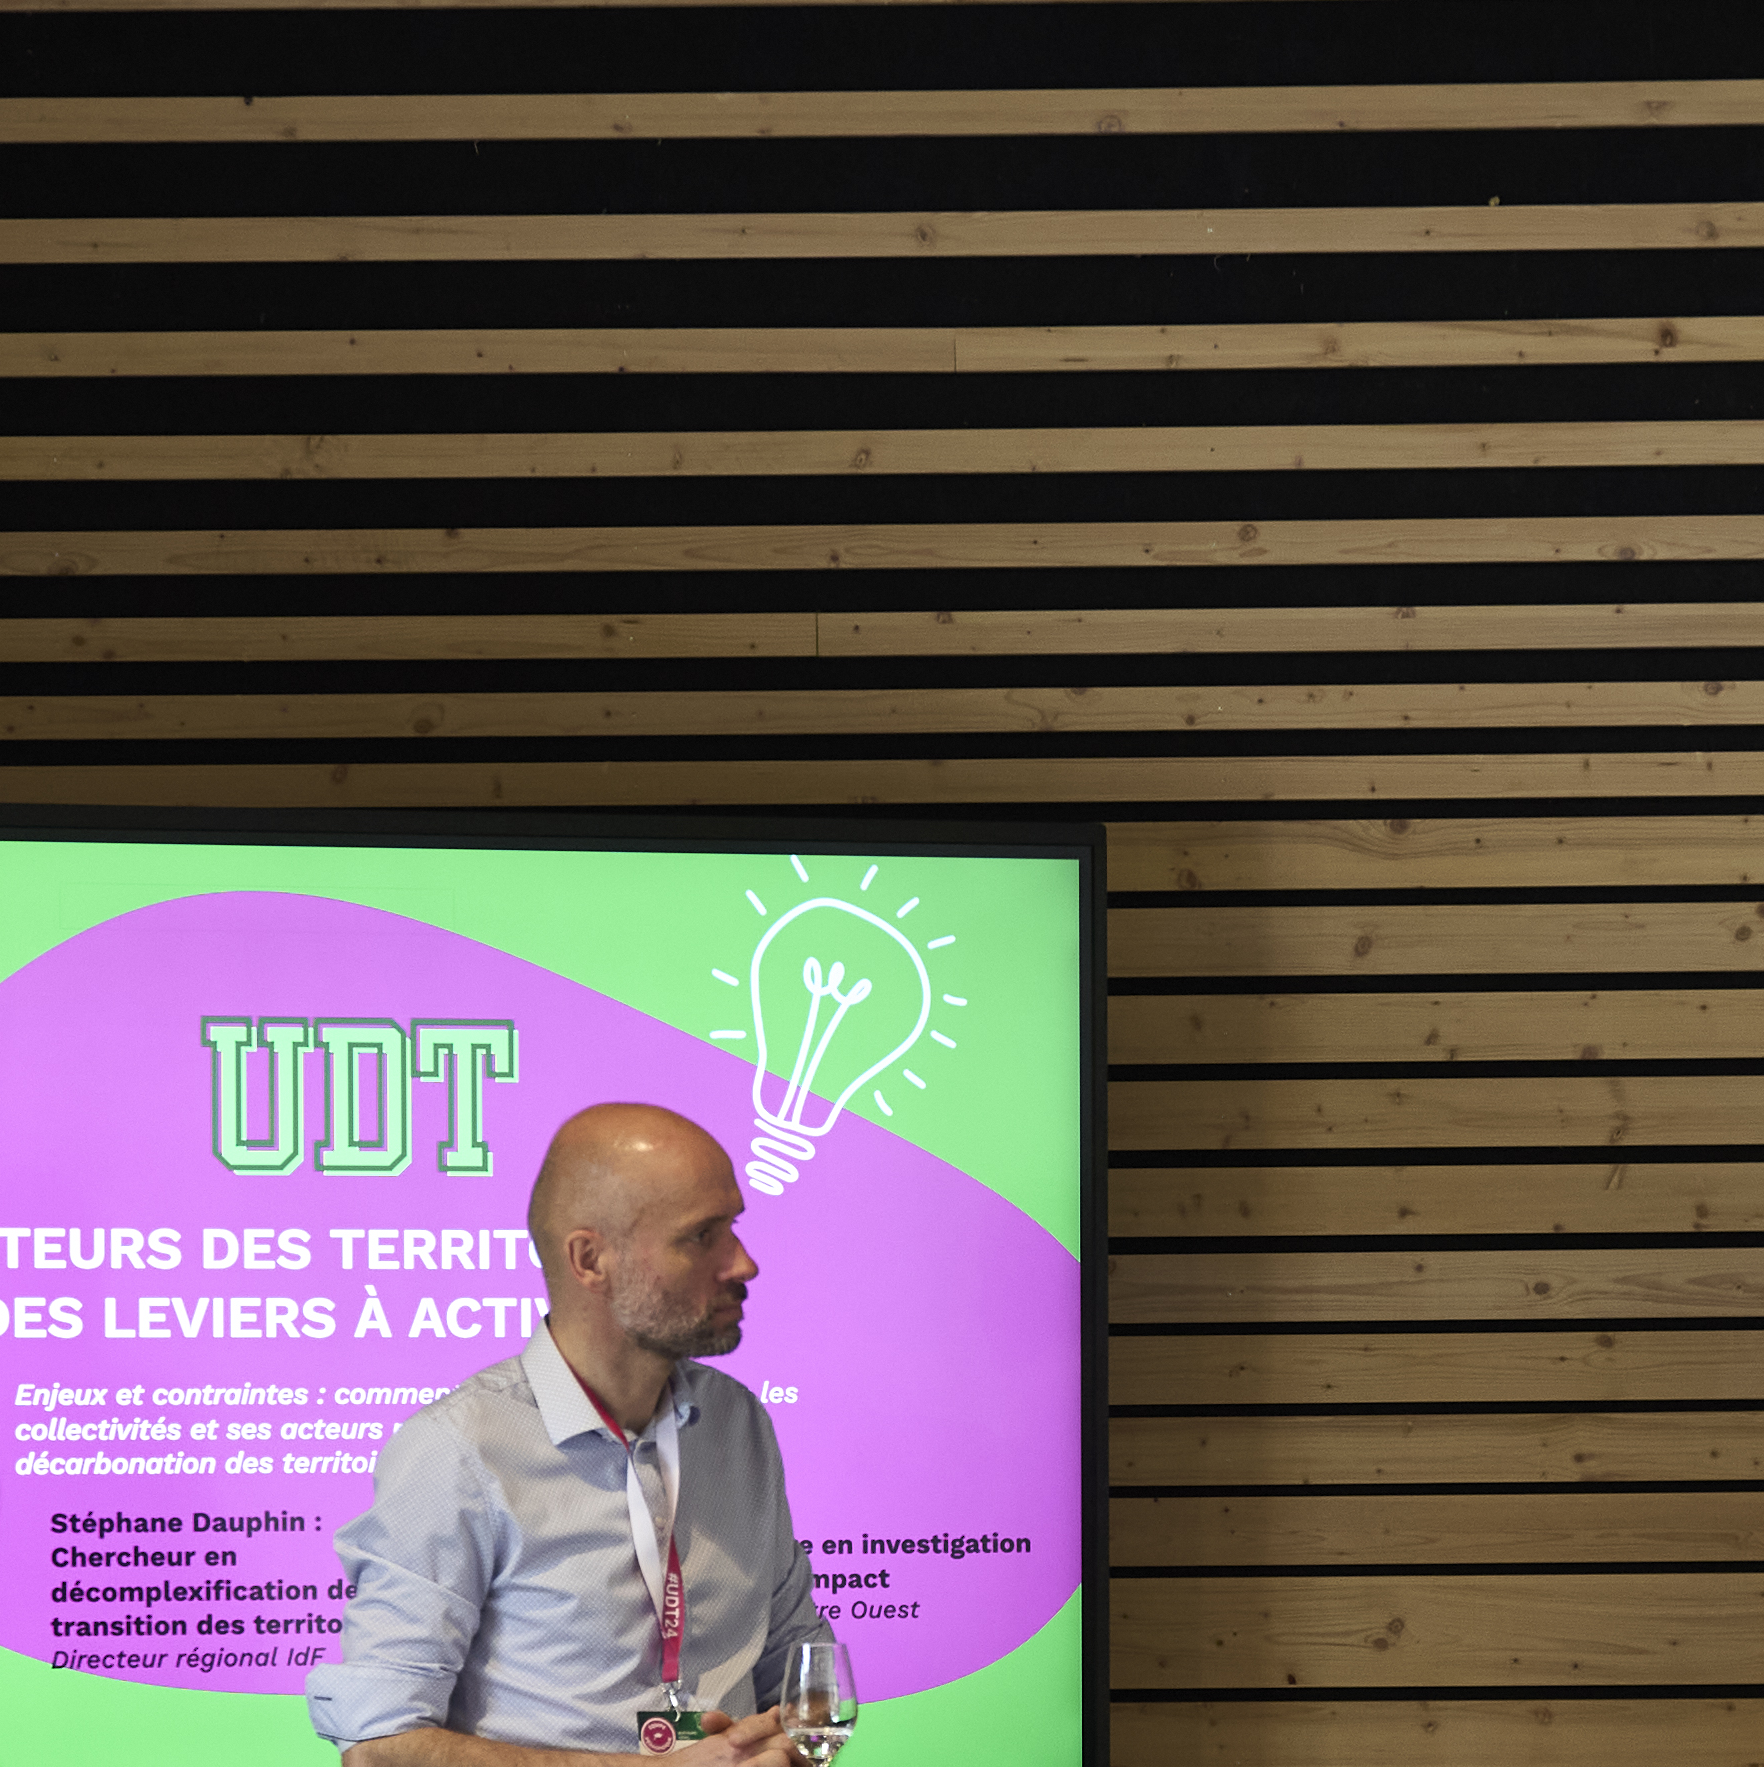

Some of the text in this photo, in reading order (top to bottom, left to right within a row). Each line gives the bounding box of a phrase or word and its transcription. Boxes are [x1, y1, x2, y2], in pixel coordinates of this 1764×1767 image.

[200, 1015, 519, 1177] UDT
[201, 1228, 313, 1271] DES
[104, 1296, 337, 1339] LEVIERS
[352, 1284, 394, 1339] À
[14, 1382, 109, 1412] Enjeux
[115, 1384, 146, 1406] et
[151, 1382, 309, 1406] contraintes
[760, 1380, 800, 1404] les
[14, 1416, 182, 1442] collectivités
[189, 1419, 220, 1441] et
[225, 1422, 273, 1441] ses
[280, 1419, 384, 1441] acteurs
[14, 1450, 378, 1476] décarbonation des territoi
[50, 1511, 184, 1540] Stéphane
[192, 1510, 306, 1539] Dauphin
[50, 1545, 237, 1568] Chercheur en
[821, 1539, 853, 1555] en
[861, 1532, 1032, 1560] investigation
[50, 1578, 357, 1608] décomplexification de
[813, 1569, 891, 1595] mpact
[664, 1572, 680, 1638] #UDT24
[815, 1600, 921, 1620] re Ouest
[50, 1612, 343, 1638] transition des territo
[51, 1646, 327, 1673] Directeur régional IdF
